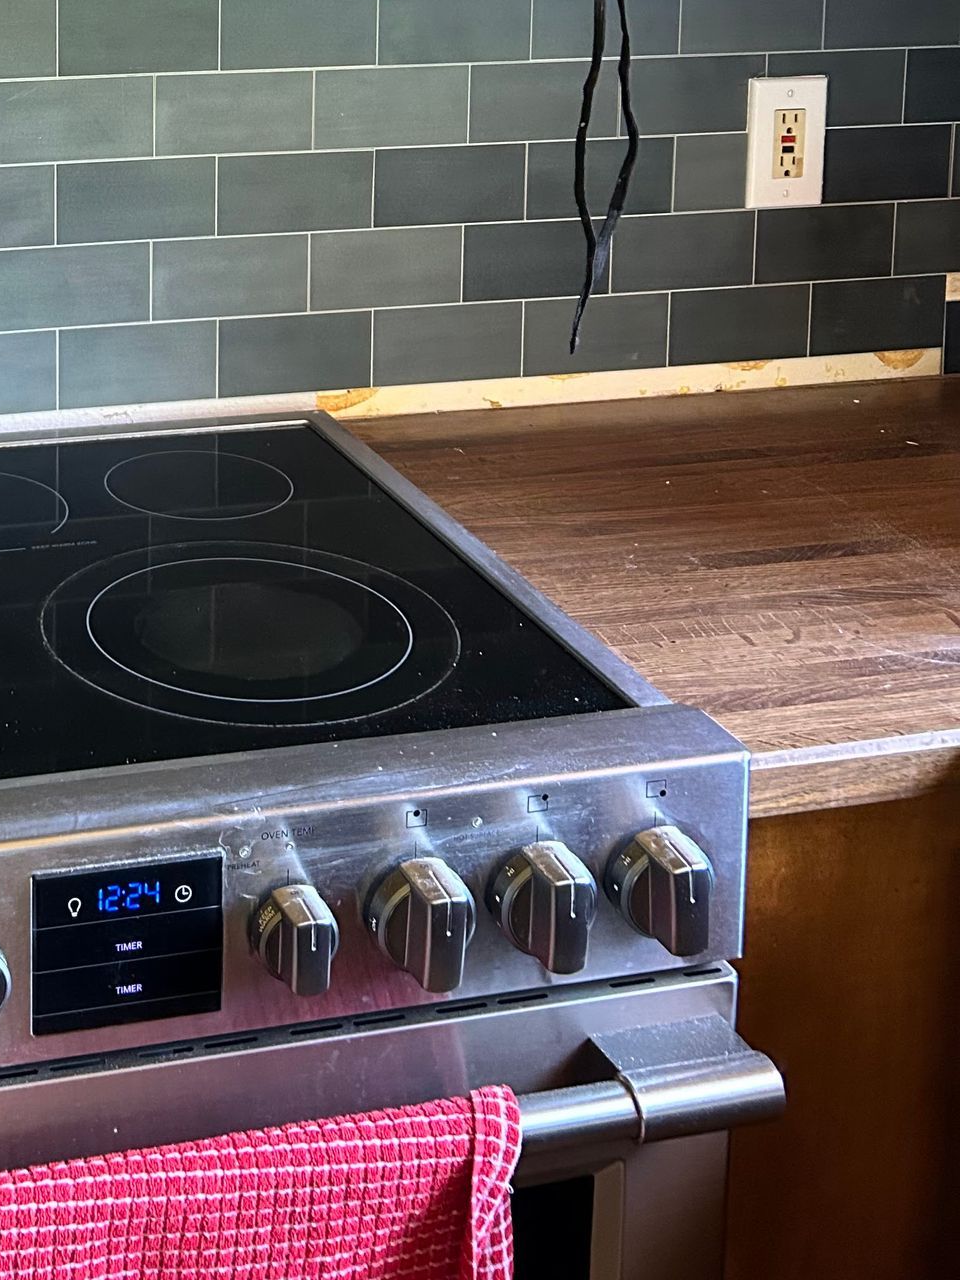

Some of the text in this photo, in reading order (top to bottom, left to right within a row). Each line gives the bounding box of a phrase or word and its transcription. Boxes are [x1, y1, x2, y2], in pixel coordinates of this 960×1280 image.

[261, 829, 288, 841] OVEN
[227, 860, 260, 871] PREHEAT
[98, 881, 160, 911] 12:24
[115, 940, 143, 952] TIMER
[115, 983, 143, 995] TIMER
